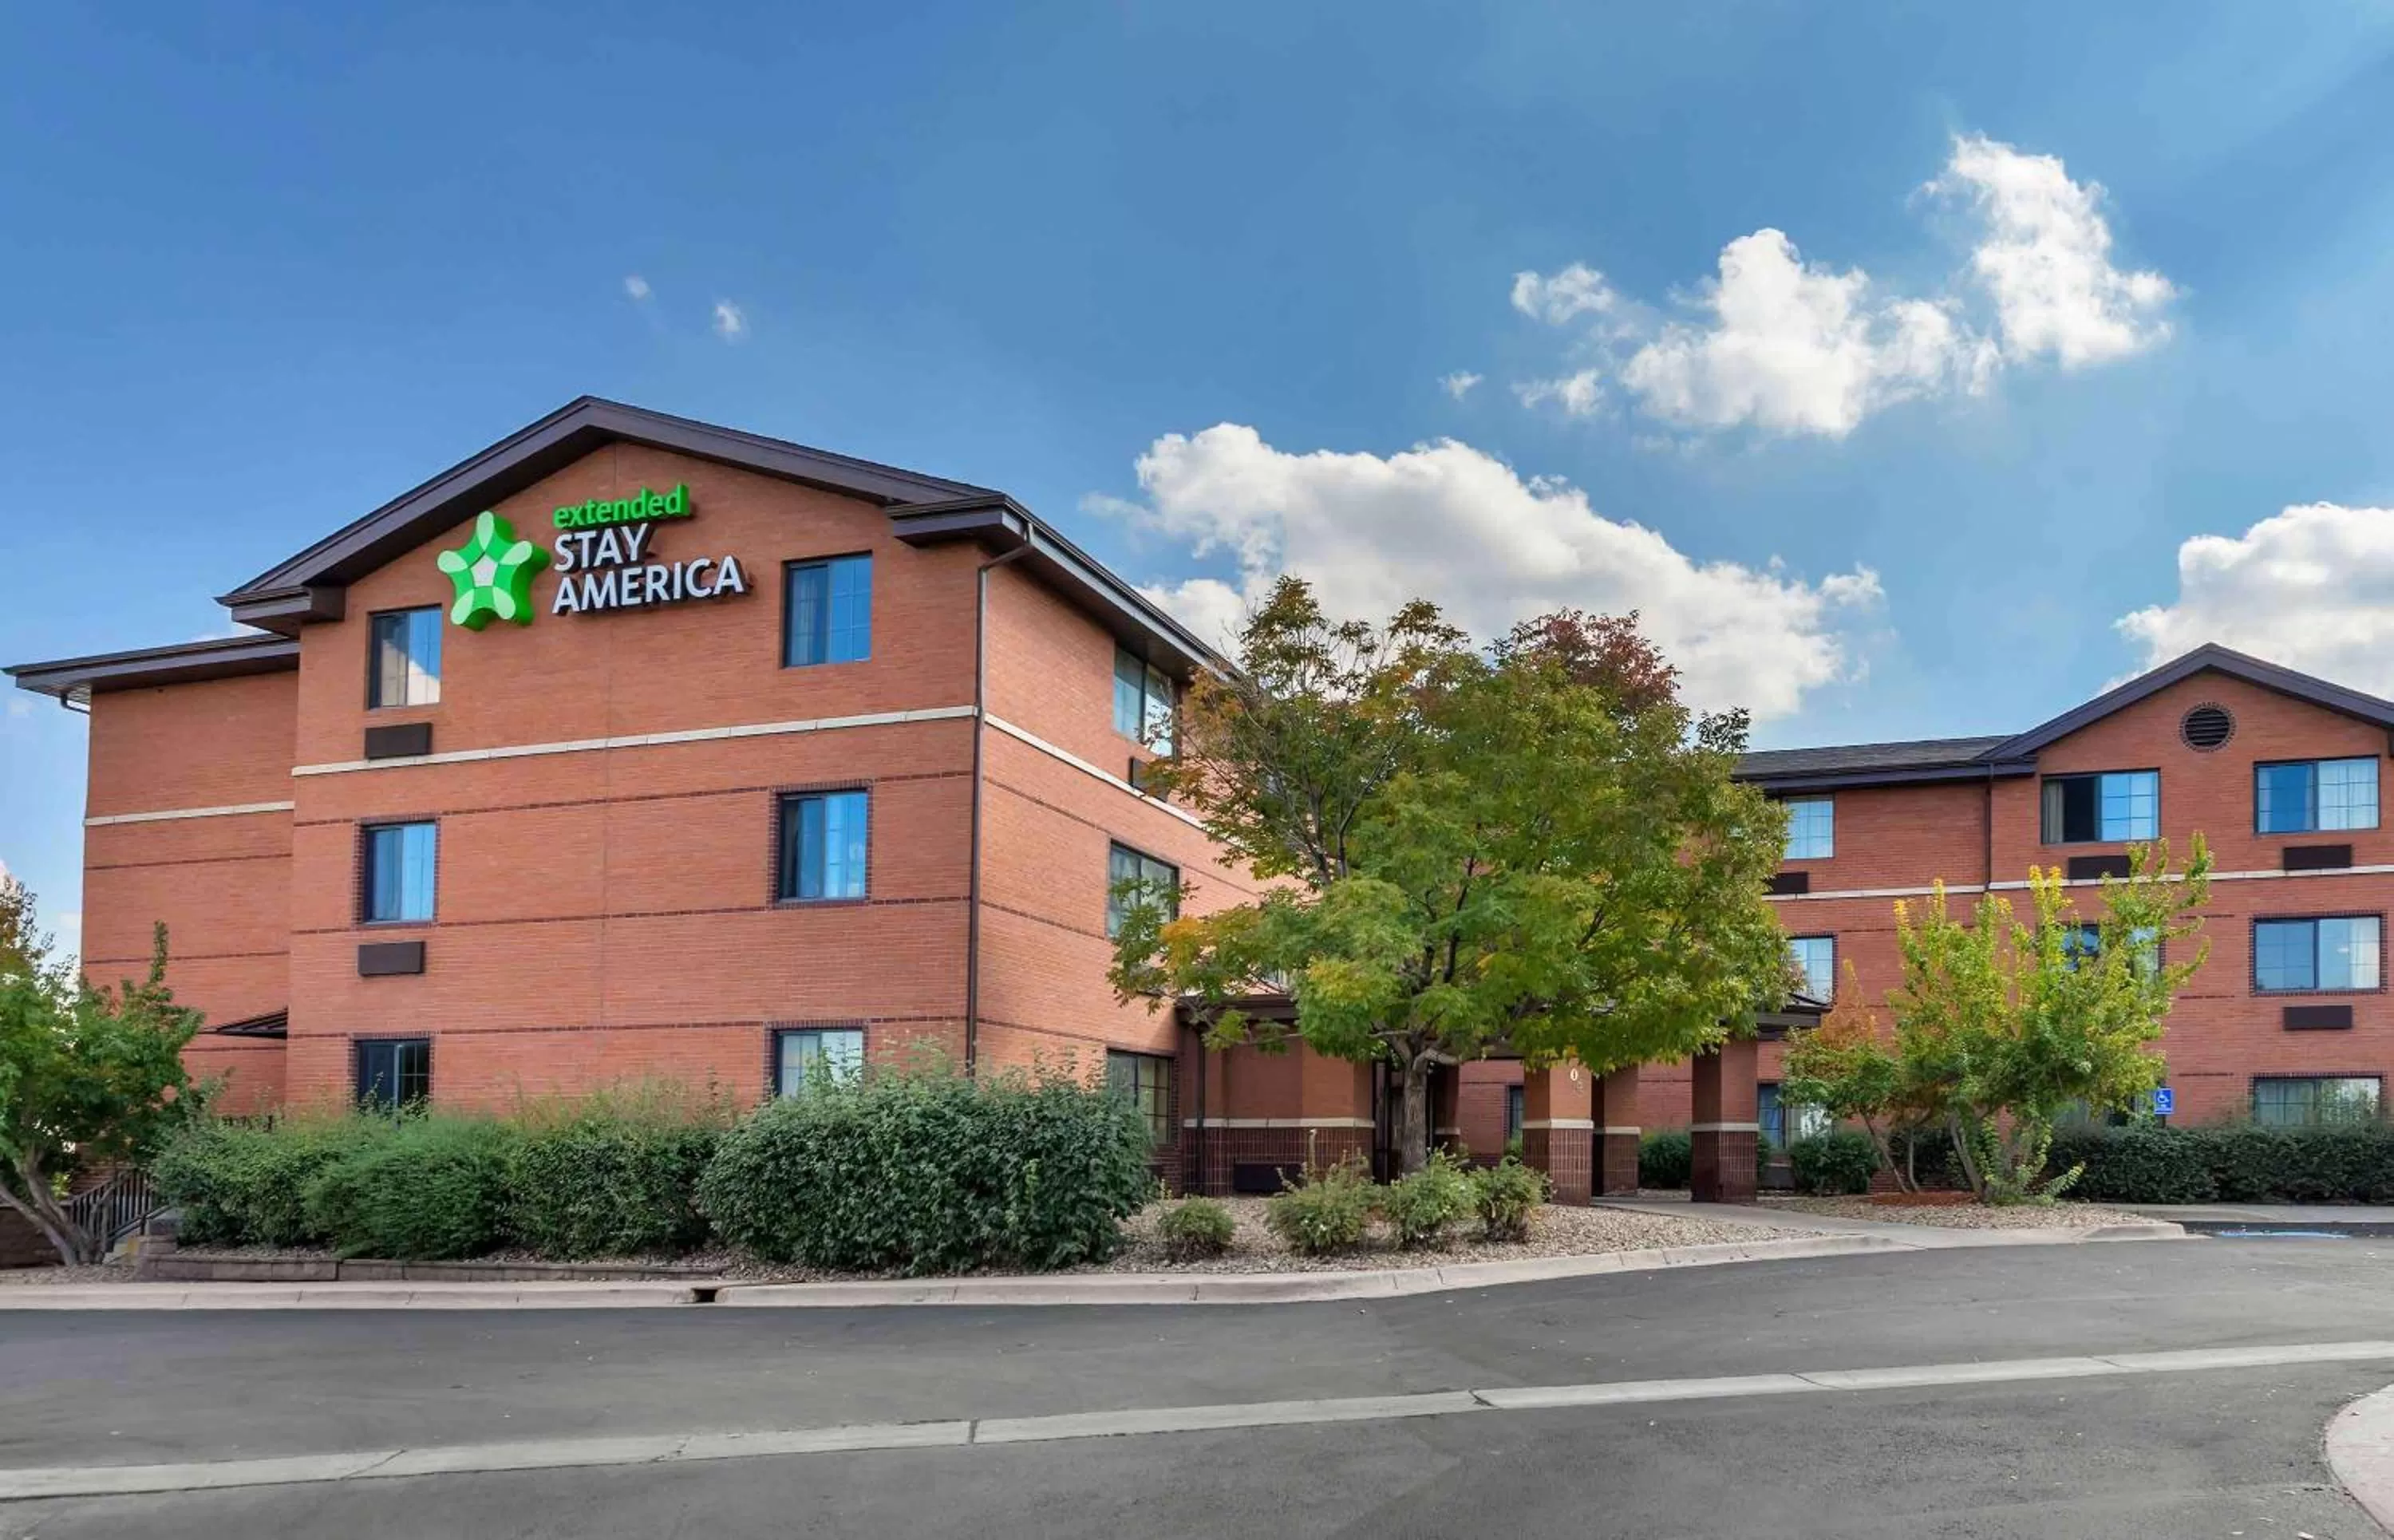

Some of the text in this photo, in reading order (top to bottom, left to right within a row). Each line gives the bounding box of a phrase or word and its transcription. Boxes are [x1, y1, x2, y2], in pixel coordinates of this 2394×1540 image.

[553, 483, 687, 527] extended
[554, 523, 650, 571] STAY
[552, 555, 746, 614] AMERICA
